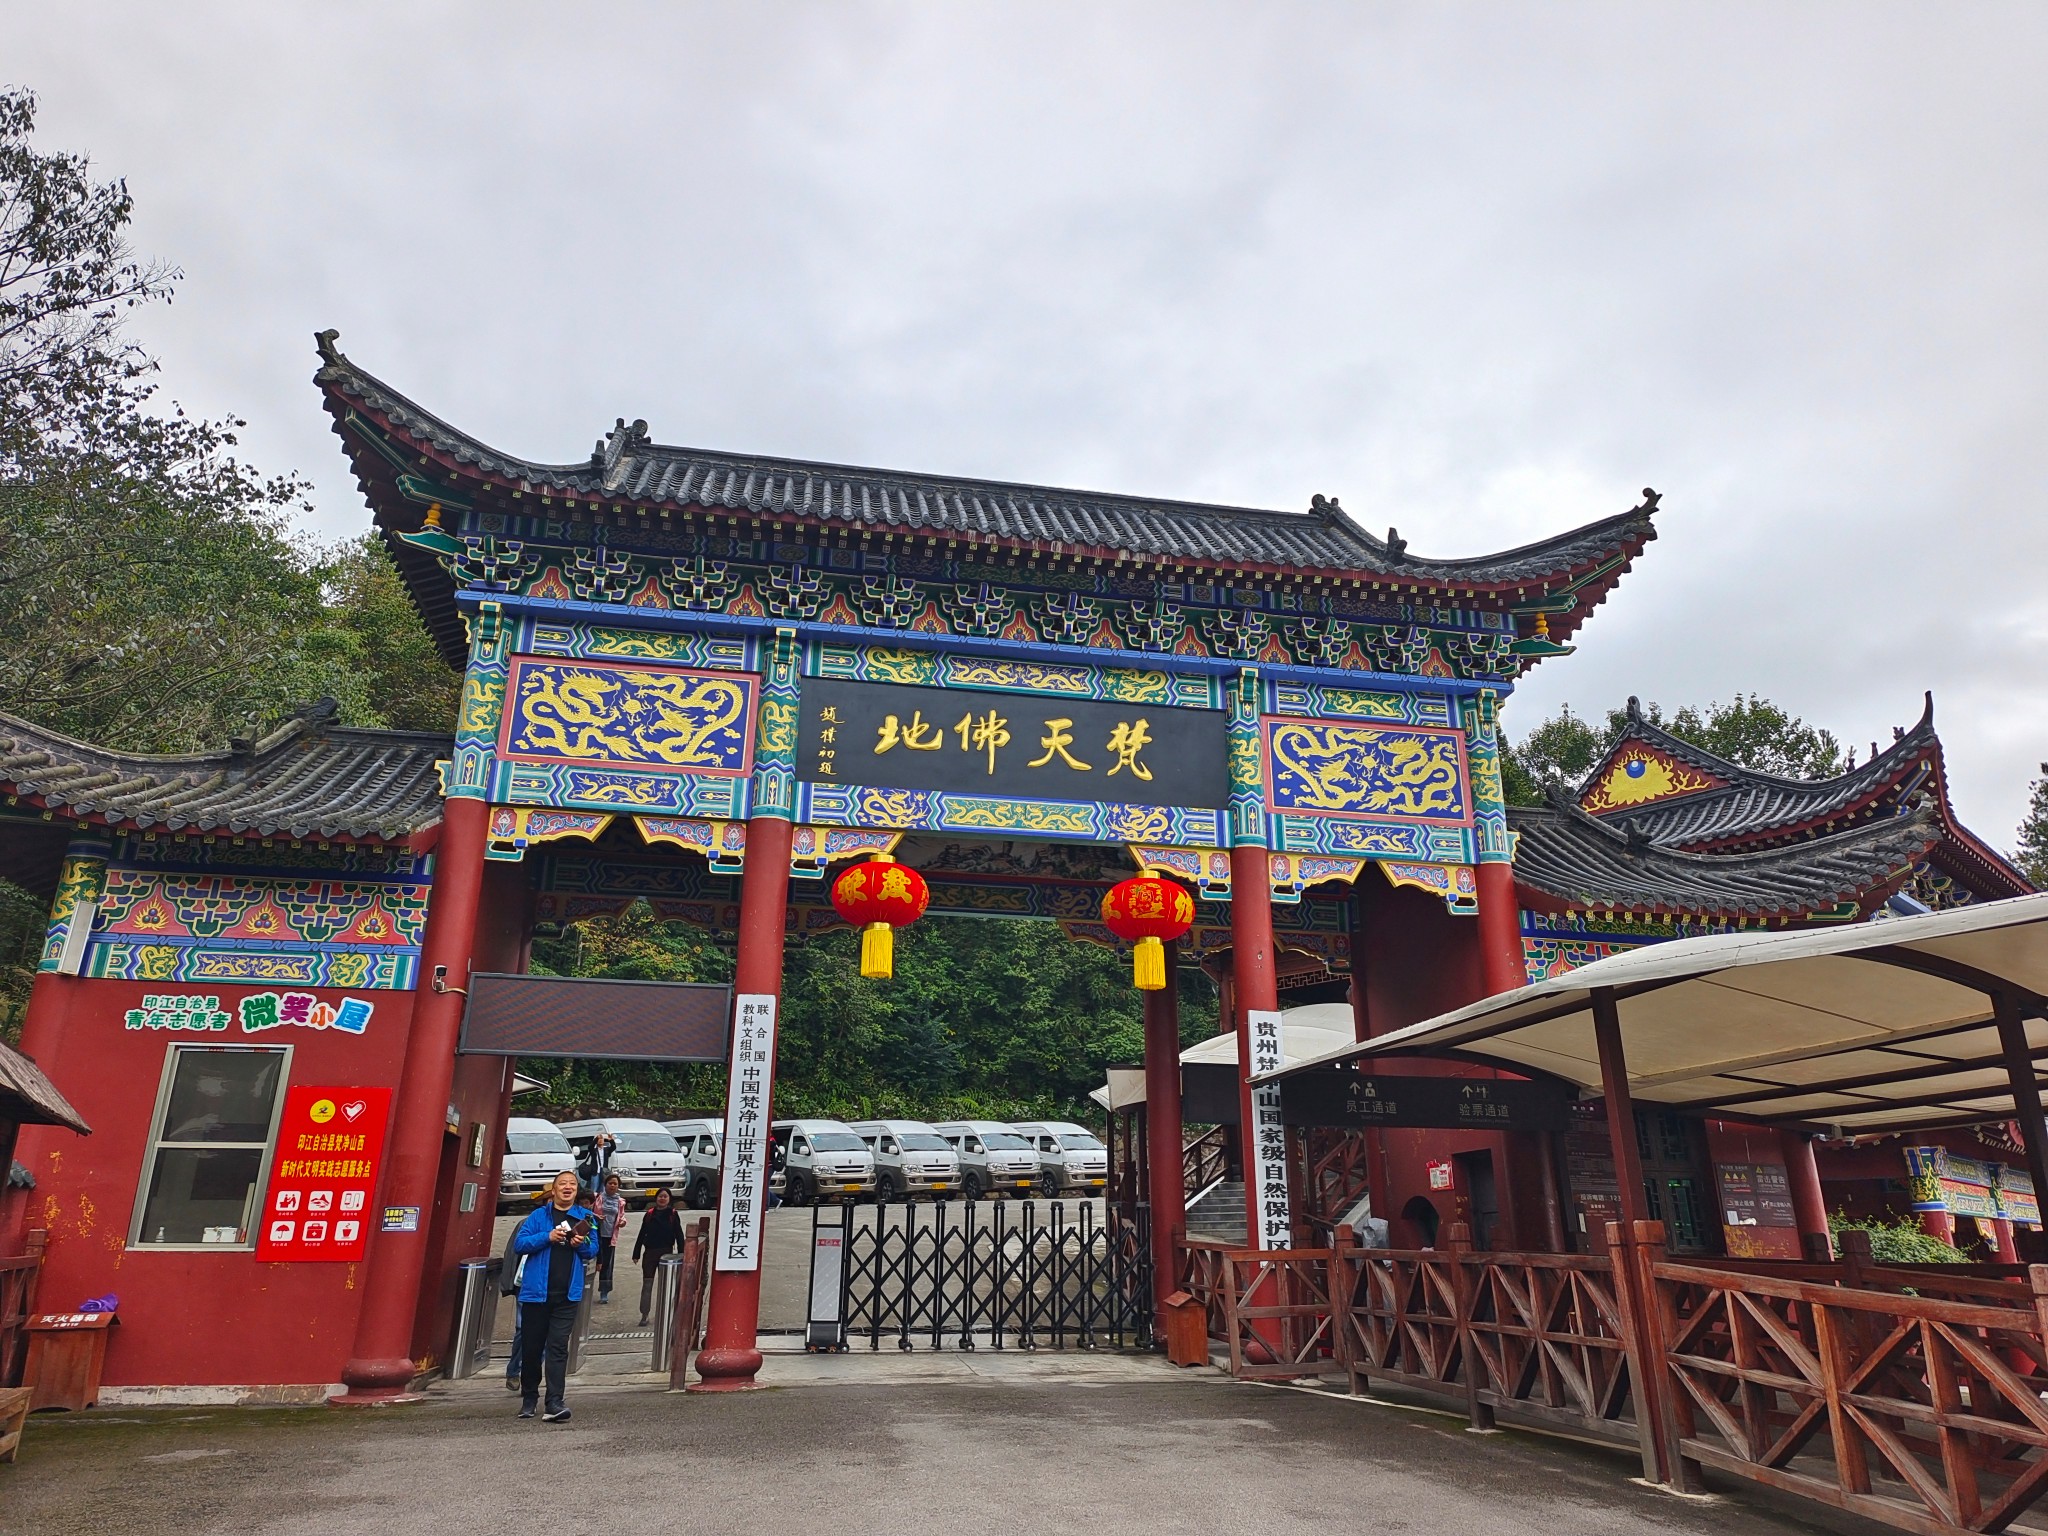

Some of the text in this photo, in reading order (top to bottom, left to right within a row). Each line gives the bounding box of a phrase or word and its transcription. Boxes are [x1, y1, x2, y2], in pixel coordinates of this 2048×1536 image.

[144, 996, 220, 1010] 印江自治县
[243, 994, 372, 1031] 微笑小屋
[126, 1011, 230, 1029] 青年志愿者
[739, 1003, 755, 1063] 教科文组织
[754, 1003, 770, 1062] 联合国
[1346, 1100, 1398, 1114] 员工通道
[1459, 1103, 1510, 1118] 验票通道
[297, 1133, 366, 1152] 印江自治县梵净山西
[728, 1066, 761, 1260] 中国梵净山世界生物圈保护区
